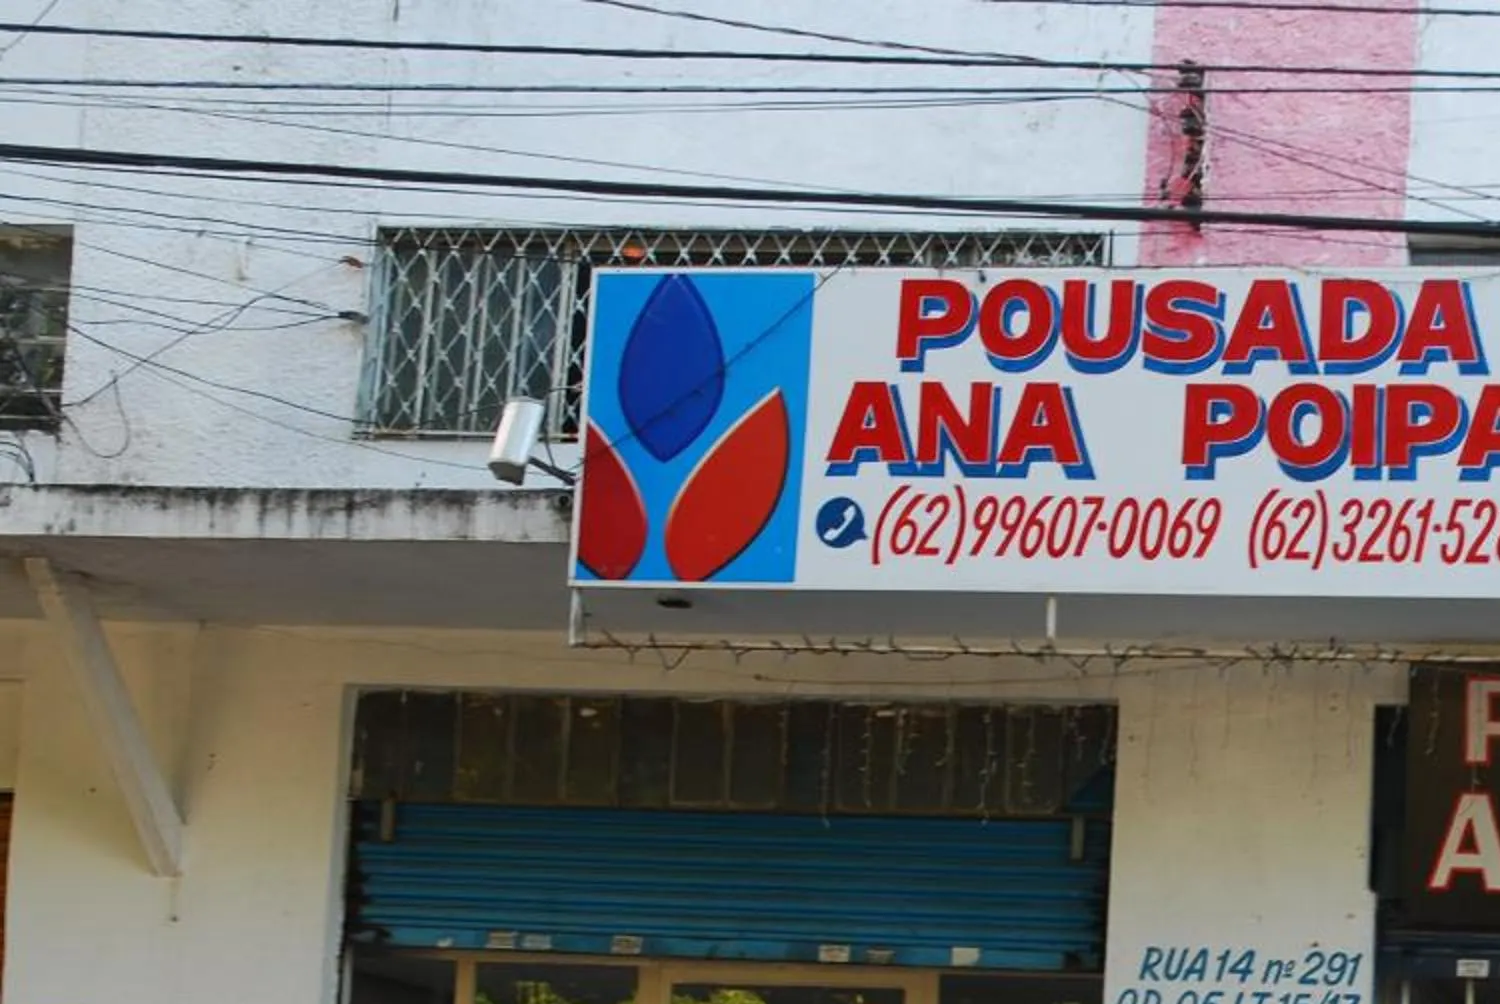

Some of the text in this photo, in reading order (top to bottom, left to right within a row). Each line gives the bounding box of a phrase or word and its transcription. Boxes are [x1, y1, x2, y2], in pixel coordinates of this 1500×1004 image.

[896, 278, 1489, 376] POUSADA
[825, 380, 1096, 480] ANA
[1139, 946, 1208, 983] RUA
[1214, 949, 1256, 983] 14
[1298, 950, 1363, 987] 291
